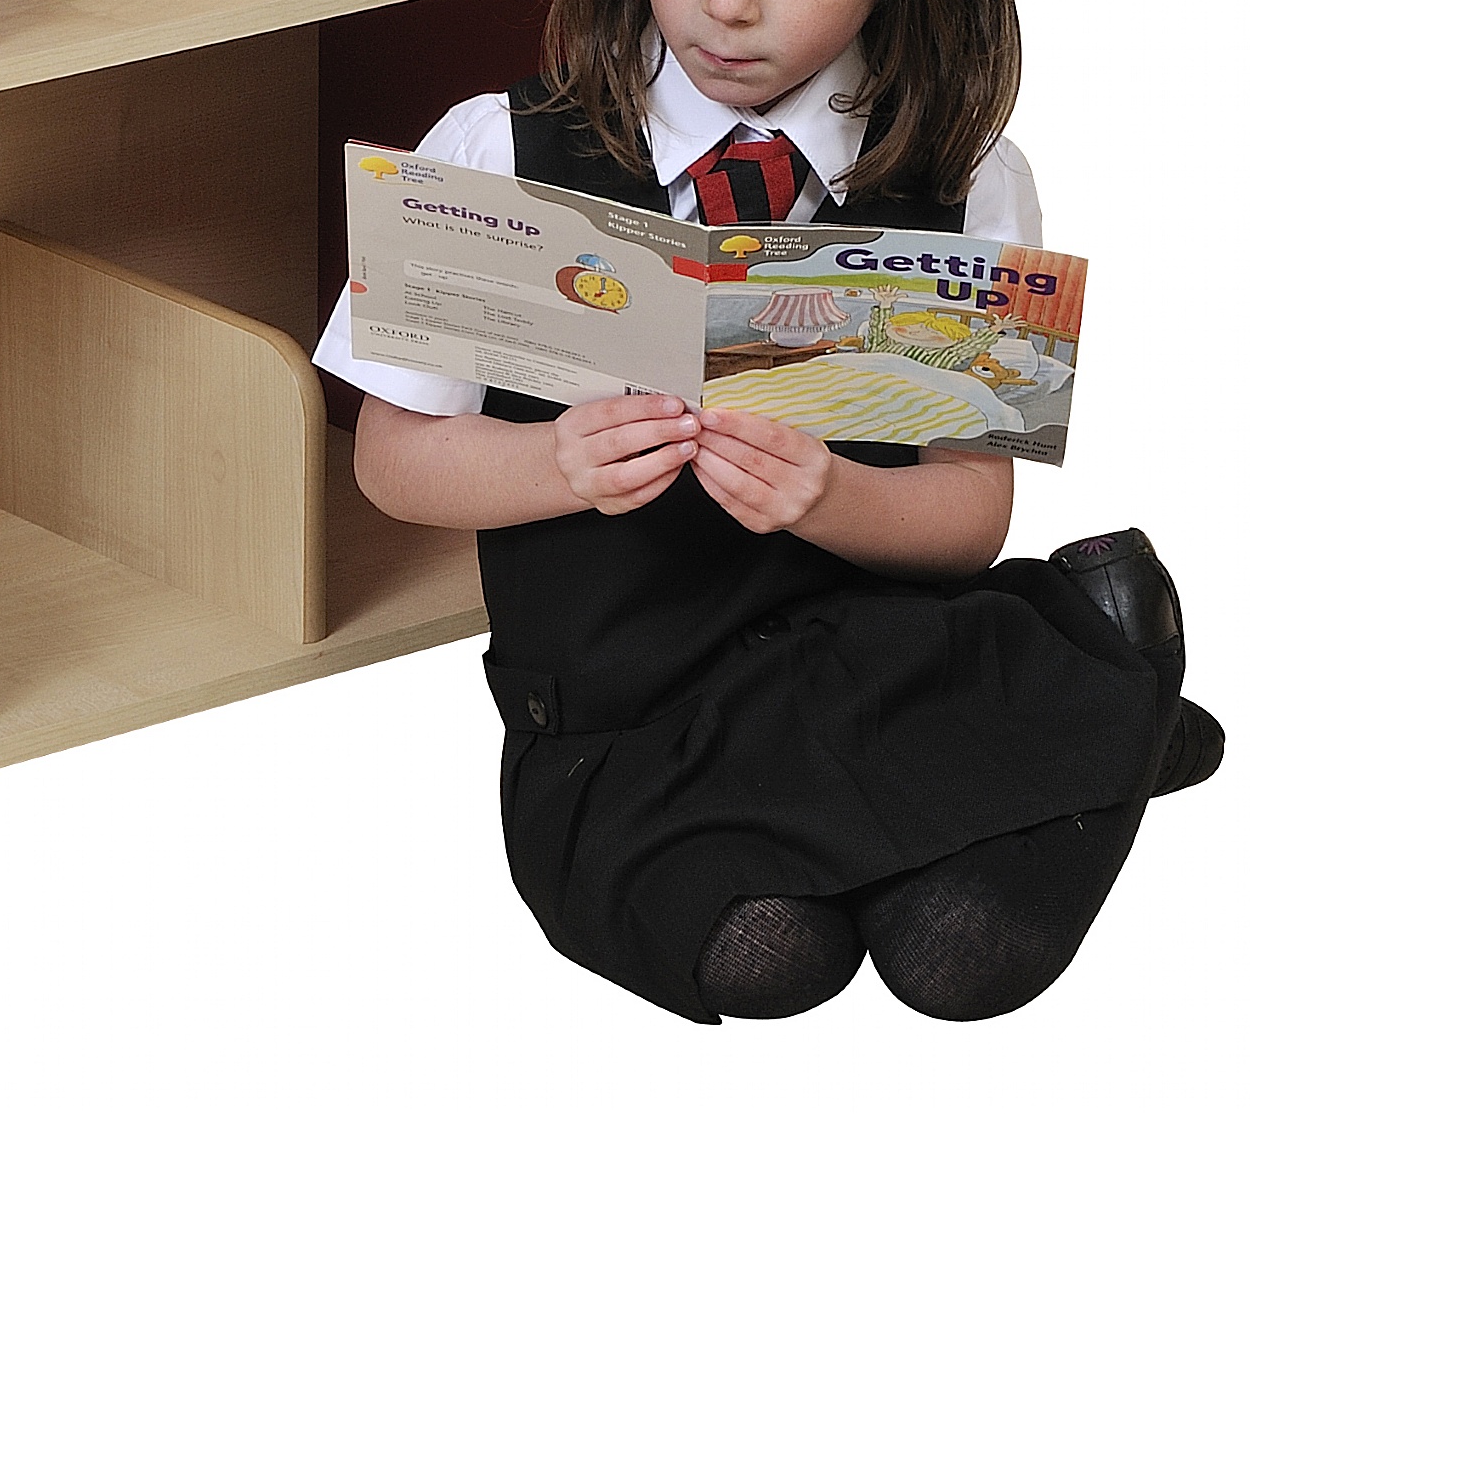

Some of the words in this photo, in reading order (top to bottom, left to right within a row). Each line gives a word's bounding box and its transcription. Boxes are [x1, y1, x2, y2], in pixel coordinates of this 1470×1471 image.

[401, 161, 437, 174] Oxford
[401, 168, 445, 183] Reading
[401, 175, 425, 185] Tree
[402, 197, 499, 228] Getting
[507, 217, 542, 236] Up
[607, 211, 640, 227] Stage
[402, 216, 441, 230] What
[445, 223, 455, 232] is
[459, 226, 482, 237] the
[486, 234, 544, 252] surprise?
[607, 221, 647, 238] Kipper
[648, 232, 687, 249] Stories
[764, 236, 802, 244] Oxford
[764, 242, 810, 251] Reading
[834, 247, 1059, 297] Getting
[935, 279, 1010, 310] Up
[369, 325, 430, 342] OXFORD
[1032, 440, 1057, 450] Hunt
